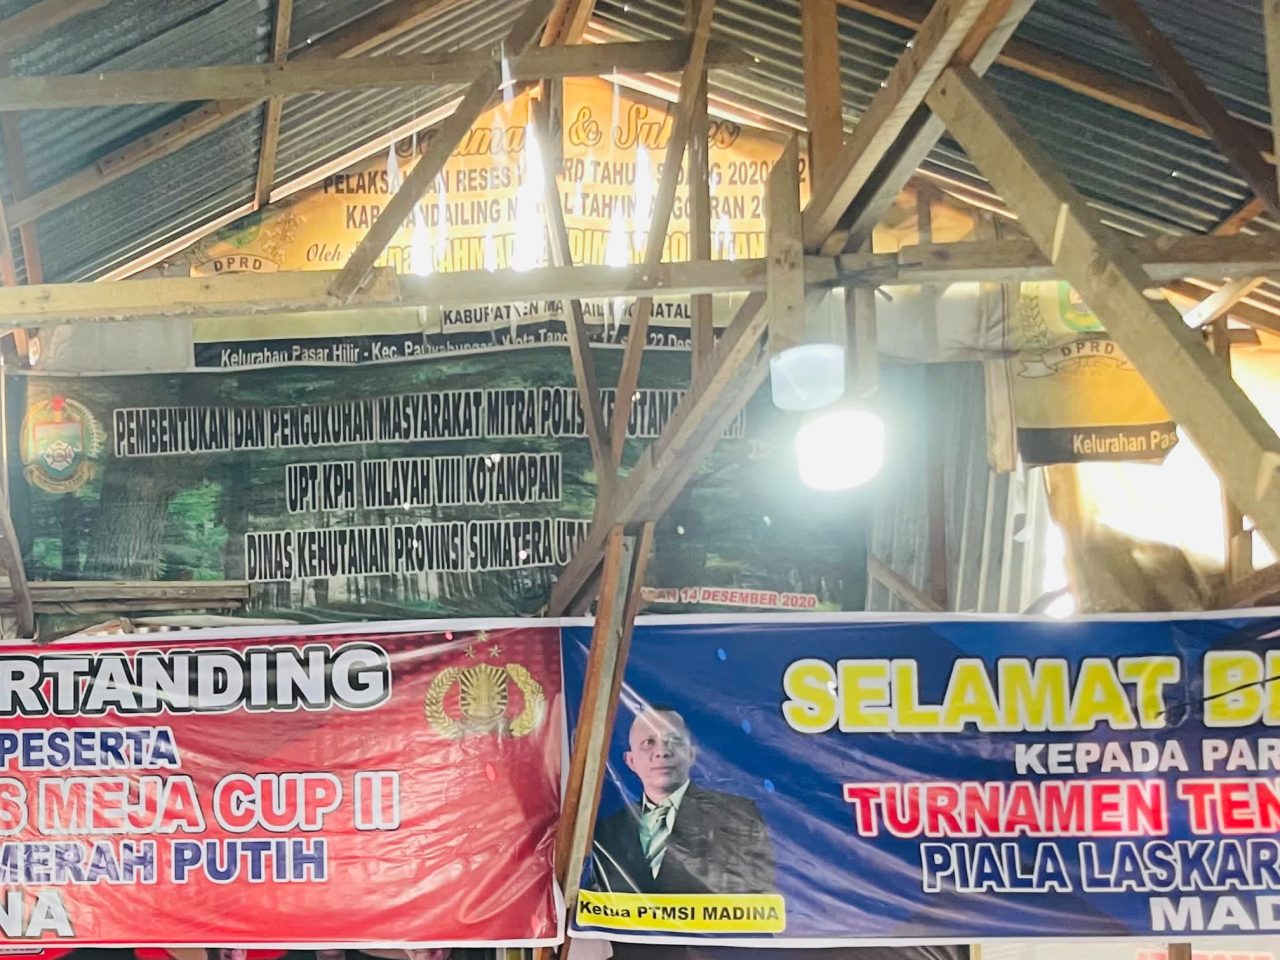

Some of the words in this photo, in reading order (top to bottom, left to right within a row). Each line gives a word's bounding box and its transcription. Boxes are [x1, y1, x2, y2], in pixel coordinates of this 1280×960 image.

[214, 257, 263, 272] DPRD
[221, 347, 288, 367] Kelurahan
[293, 345, 329, 362] Pasar
[332, 343, 360, 362] Hilir
[1061, 341, 1115, 356] DPRD
[114, 407, 231, 457] PEMBENTUKAN
[233, 405, 269, 451] DAN
[270, 400, 375, 449] PENGUKUHAN
[377, 389, 483, 443] MASYARAKAT
[484, 388, 537, 440] MITRA
[1073, 434, 1146, 454] Kelurahan
[286, 463, 319, 514] UPT
[321, 461, 357, 512] KPH
[362, 457, 432, 510] WILAYAH
[433, 456, 464, 507] VIII
[465, 452, 562, 504] KOTANOPAN
[245, 530, 294, 582] DINAS
[296, 525, 391, 579] KEHUTANAN
[392, 521, 468, 574] PROVINSI
[470, 518, 553, 572] SUMATERA
[702, 590, 778, 607] DESEMBER
[783, 655, 1180, 735] SELAMAT
[1015, 741, 1188, 775] KEPADA
[37, 773, 207, 836] MEJA
[214, 771, 344, 833] CUP
[354, 771, 401, 830] II
[844, 780, 1170, 838] TURNAMEN
[173, 838, 329, 883] PUTIH
[920, 842, 1070, 893] PIALA
[1080, 839, 1280, 891] LASKAR
[578, 900, 631, 920] Ketua
[636, 905, 698, 921] PTMSI
[702, 904, 780, 922] MADINA
